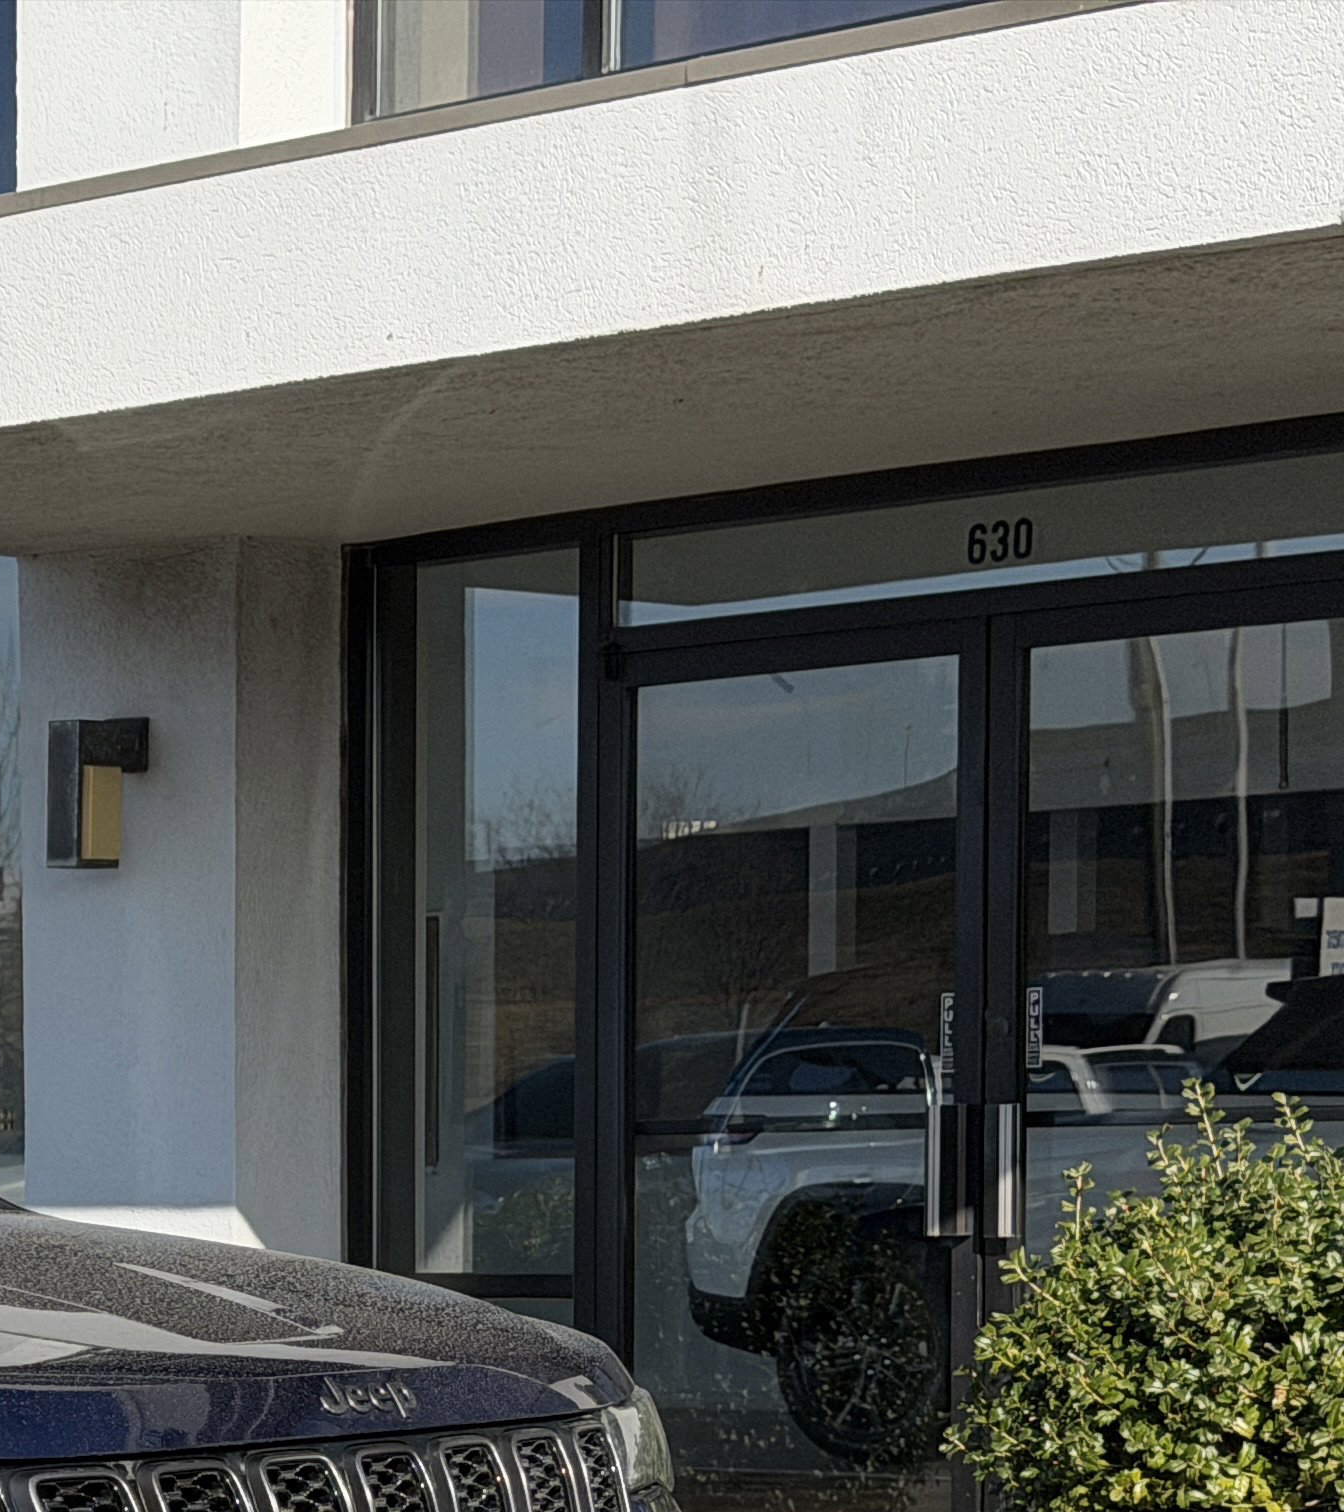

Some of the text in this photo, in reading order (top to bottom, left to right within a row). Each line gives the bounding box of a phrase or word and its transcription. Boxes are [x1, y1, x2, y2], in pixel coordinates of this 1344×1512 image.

[967, 517, 1033, 565] 630
[944, 997, 954, 1047] PULL
[1029, 992, 1040, 1042] PULL
[319, 1376, 417, 1419] Jeep
